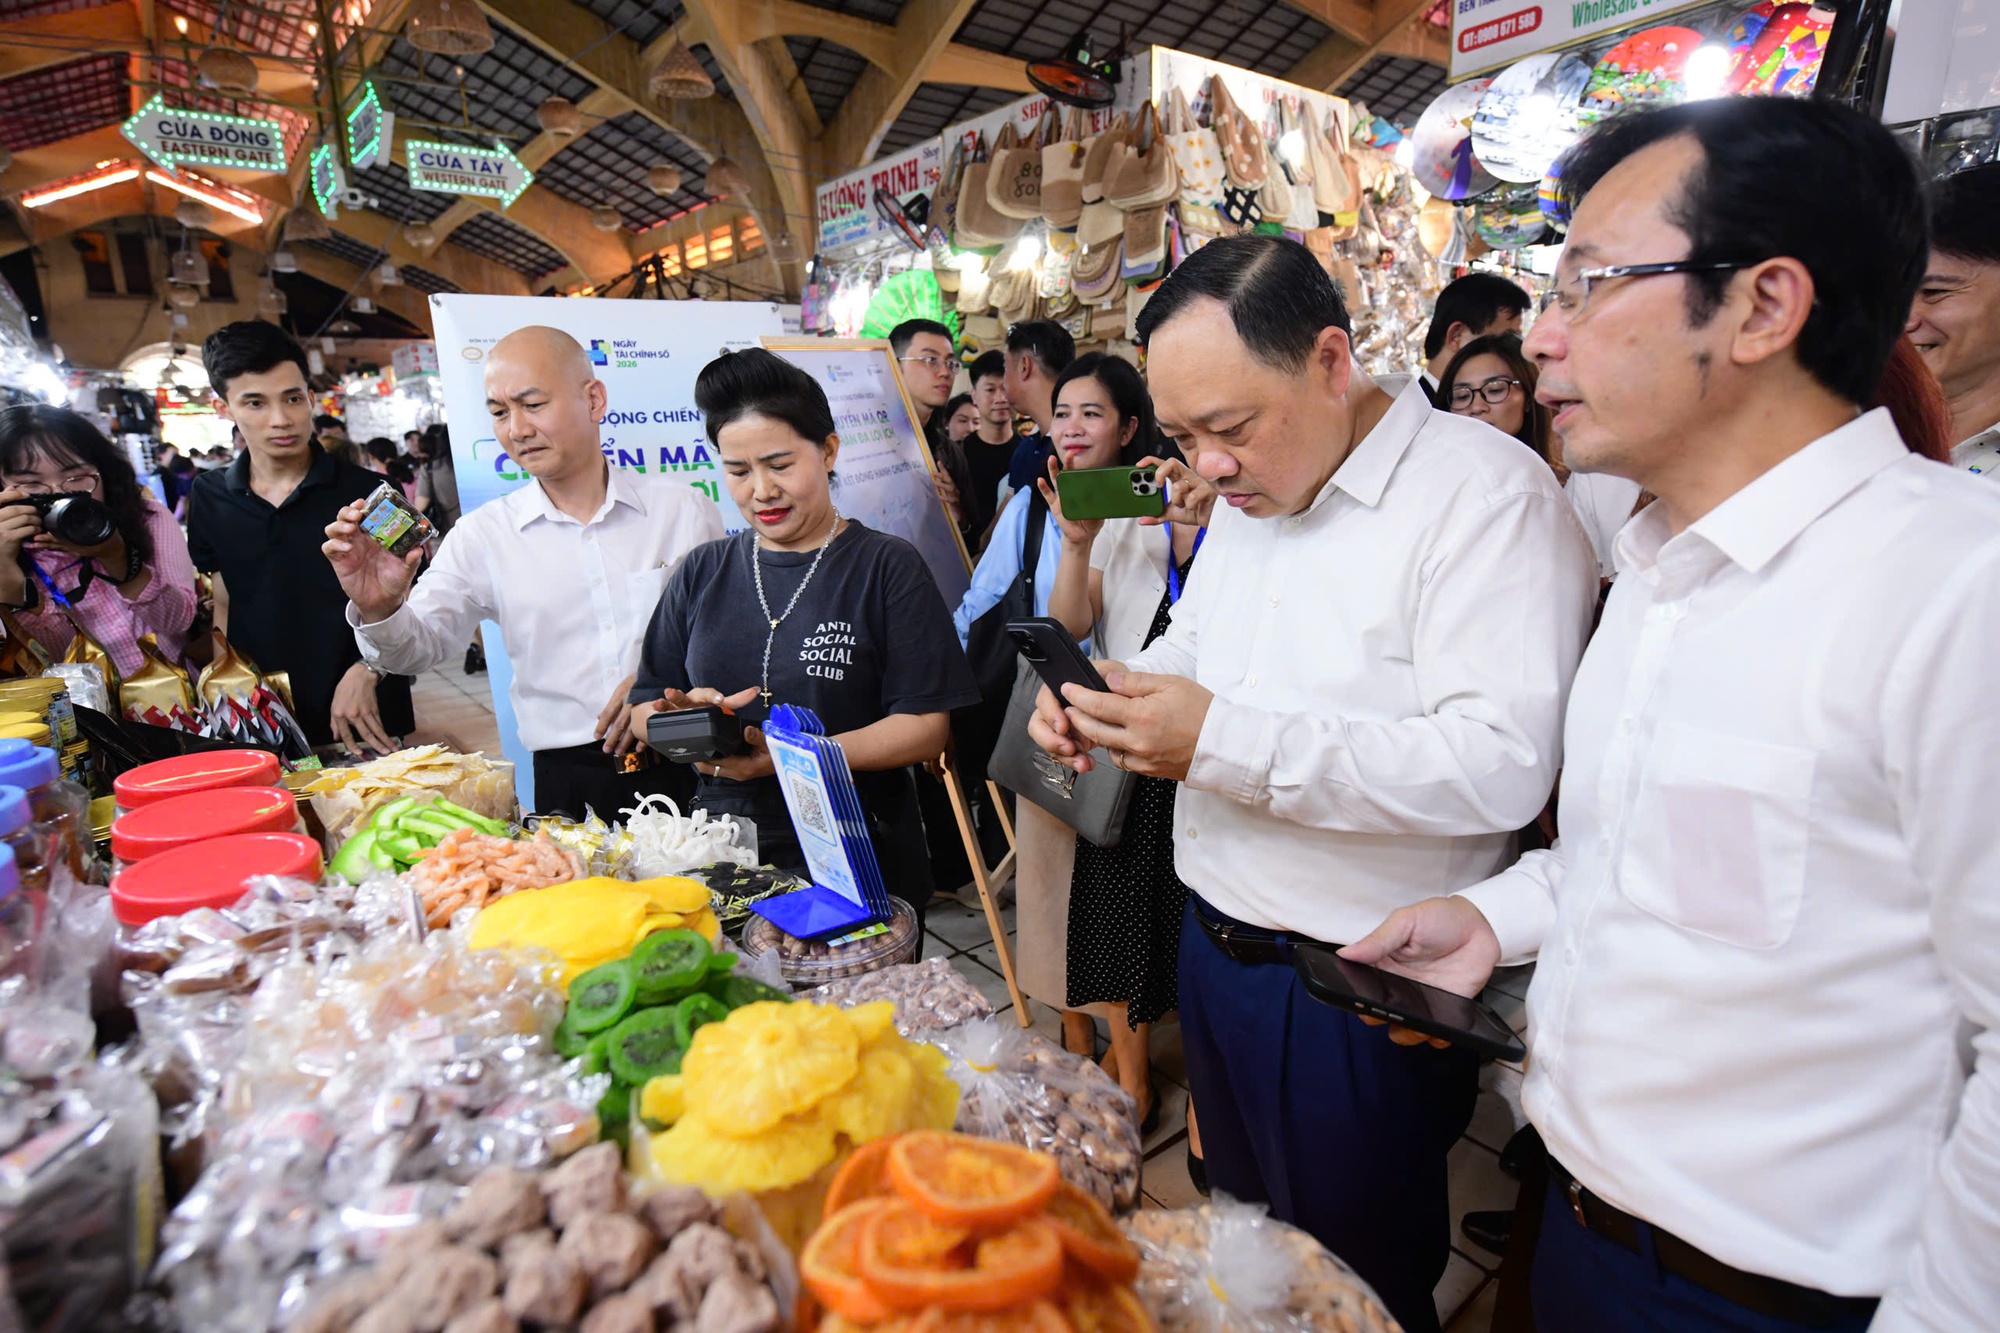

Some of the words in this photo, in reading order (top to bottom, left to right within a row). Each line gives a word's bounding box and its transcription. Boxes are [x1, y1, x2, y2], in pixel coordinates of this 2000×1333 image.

[158, 117, 203, 139] CỬA
[210, 125, 270, 147] ĐÔNG
[161, 140, 230, 158] EASTERN
[235, 149, 273, 163] GATE
[419, 151, 463, 170] CỬA
[469, 157, 503, 174] TÂY
[423, 171, 475, 187] WESTERN
[479, 178, 507, 191] GATE
[871, 158, 919, 197] TRINH
[612, 339, 637, 348] NGÀY
[614, 349, 629, 359] TÀI
[629, 349, 657, 359] CHÍNH
[616, 360, 637, 368] 2026
[653, 407, 700, 424] CHIẾN
[660, 438, 715, 473] MÃ
[815, 621, 851, 633] ANTI
[802, 633, 857, 648] SOCIAL
[798, 647, 853, 665] SOCIAL
[806, 664, 844, 681] CLUB
